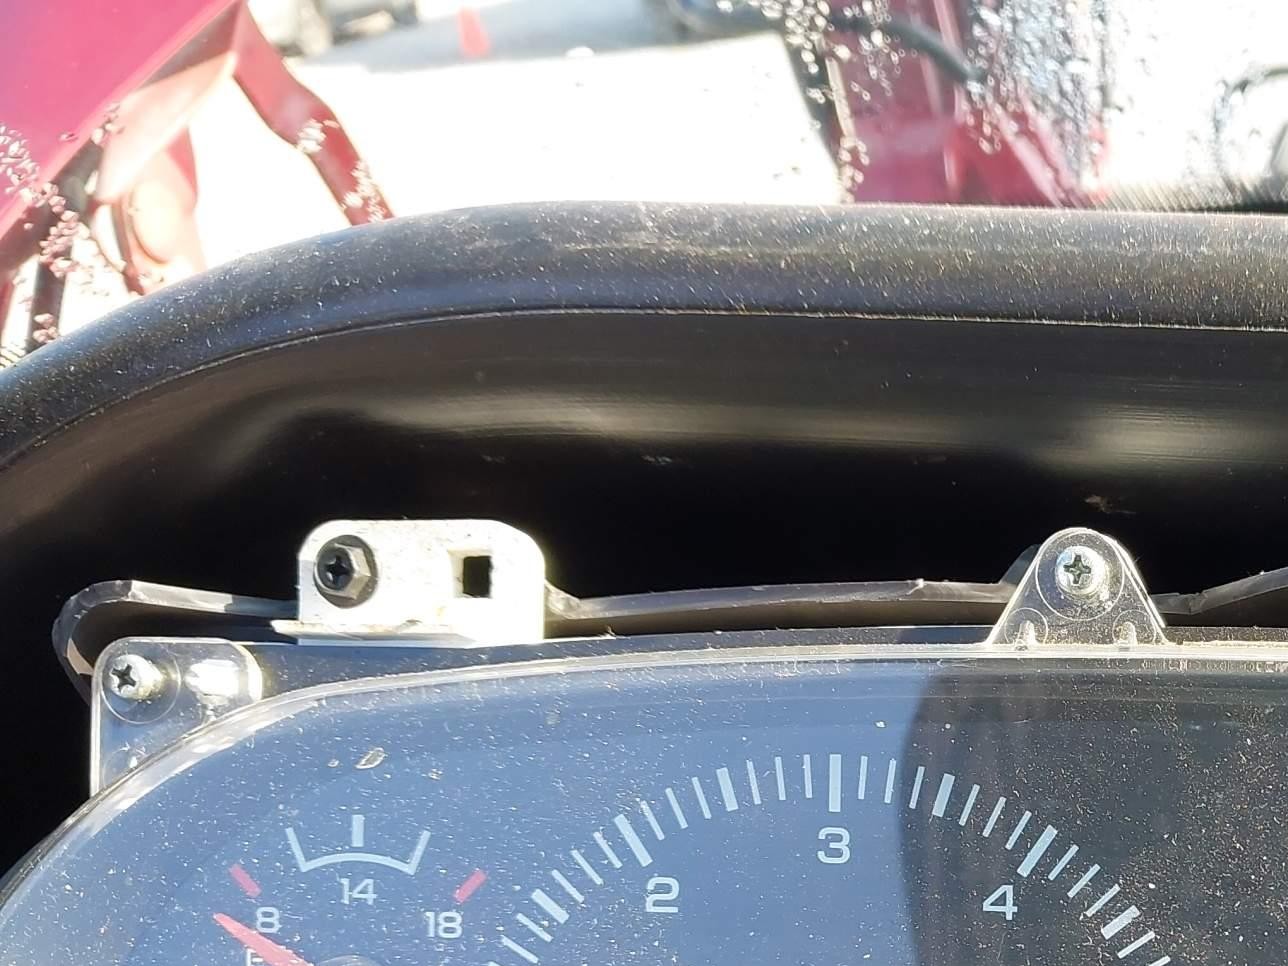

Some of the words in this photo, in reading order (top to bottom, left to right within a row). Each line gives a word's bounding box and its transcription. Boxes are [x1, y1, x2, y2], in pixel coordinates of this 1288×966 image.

[817, 827, 852, 864] 3
[341, 878, 377, 905] 14
[645, 878, 680, 913] 2
[983, 884, 1018, 921] 4
[255, 906, 281, 934] 8
[424, 911, 463, 939] 18
